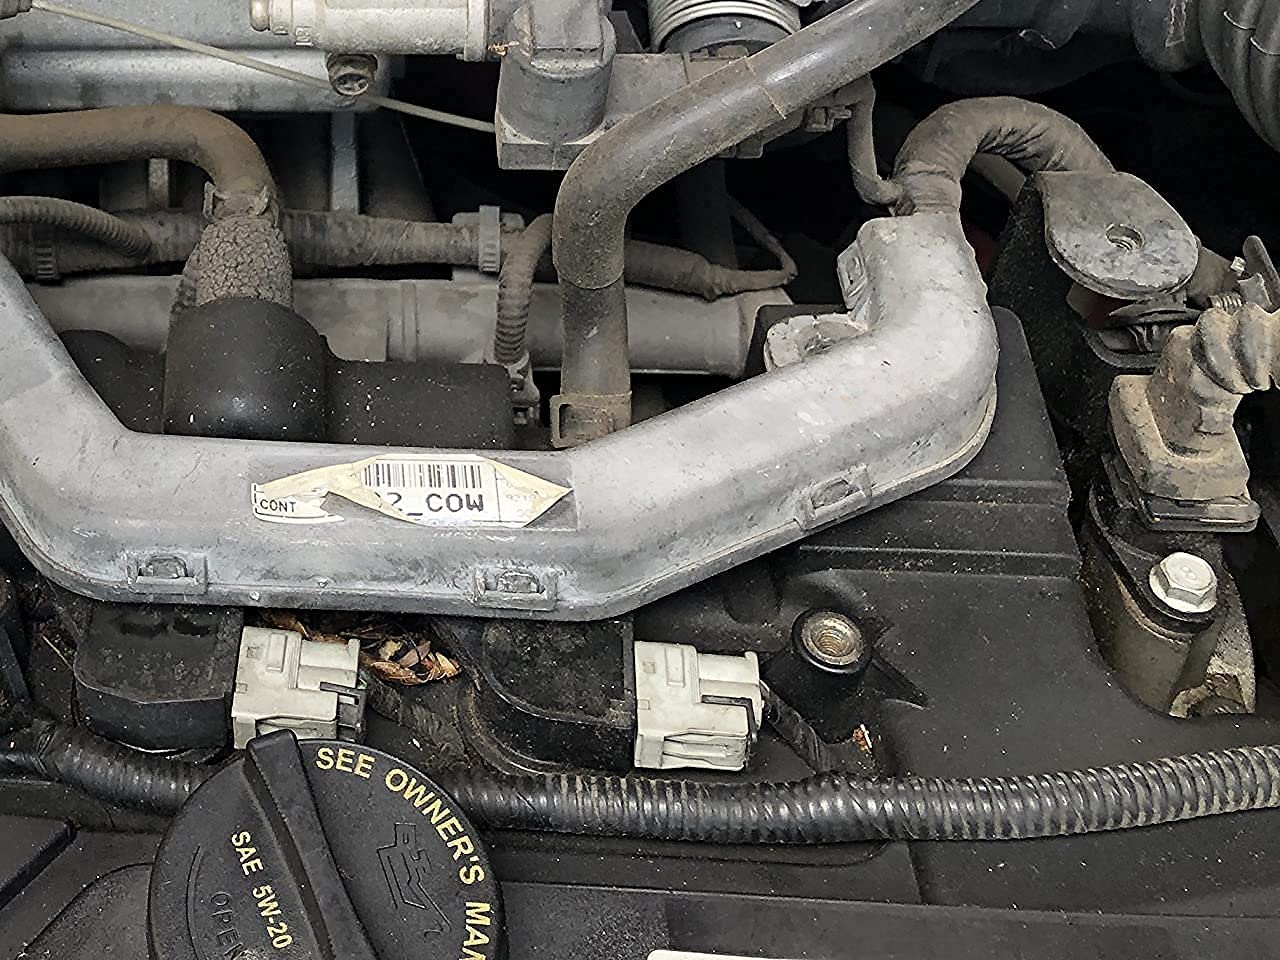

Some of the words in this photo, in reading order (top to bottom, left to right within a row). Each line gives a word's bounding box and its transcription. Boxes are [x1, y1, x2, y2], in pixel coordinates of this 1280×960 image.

[259, 498, 298, 515] CONT
[316, 746, 377, 780] SEE
[384, 768, 486, 885] OWNER'S
[231, 830, 265, 877] SAE
[251, 884, 293, 950] 5W-20
